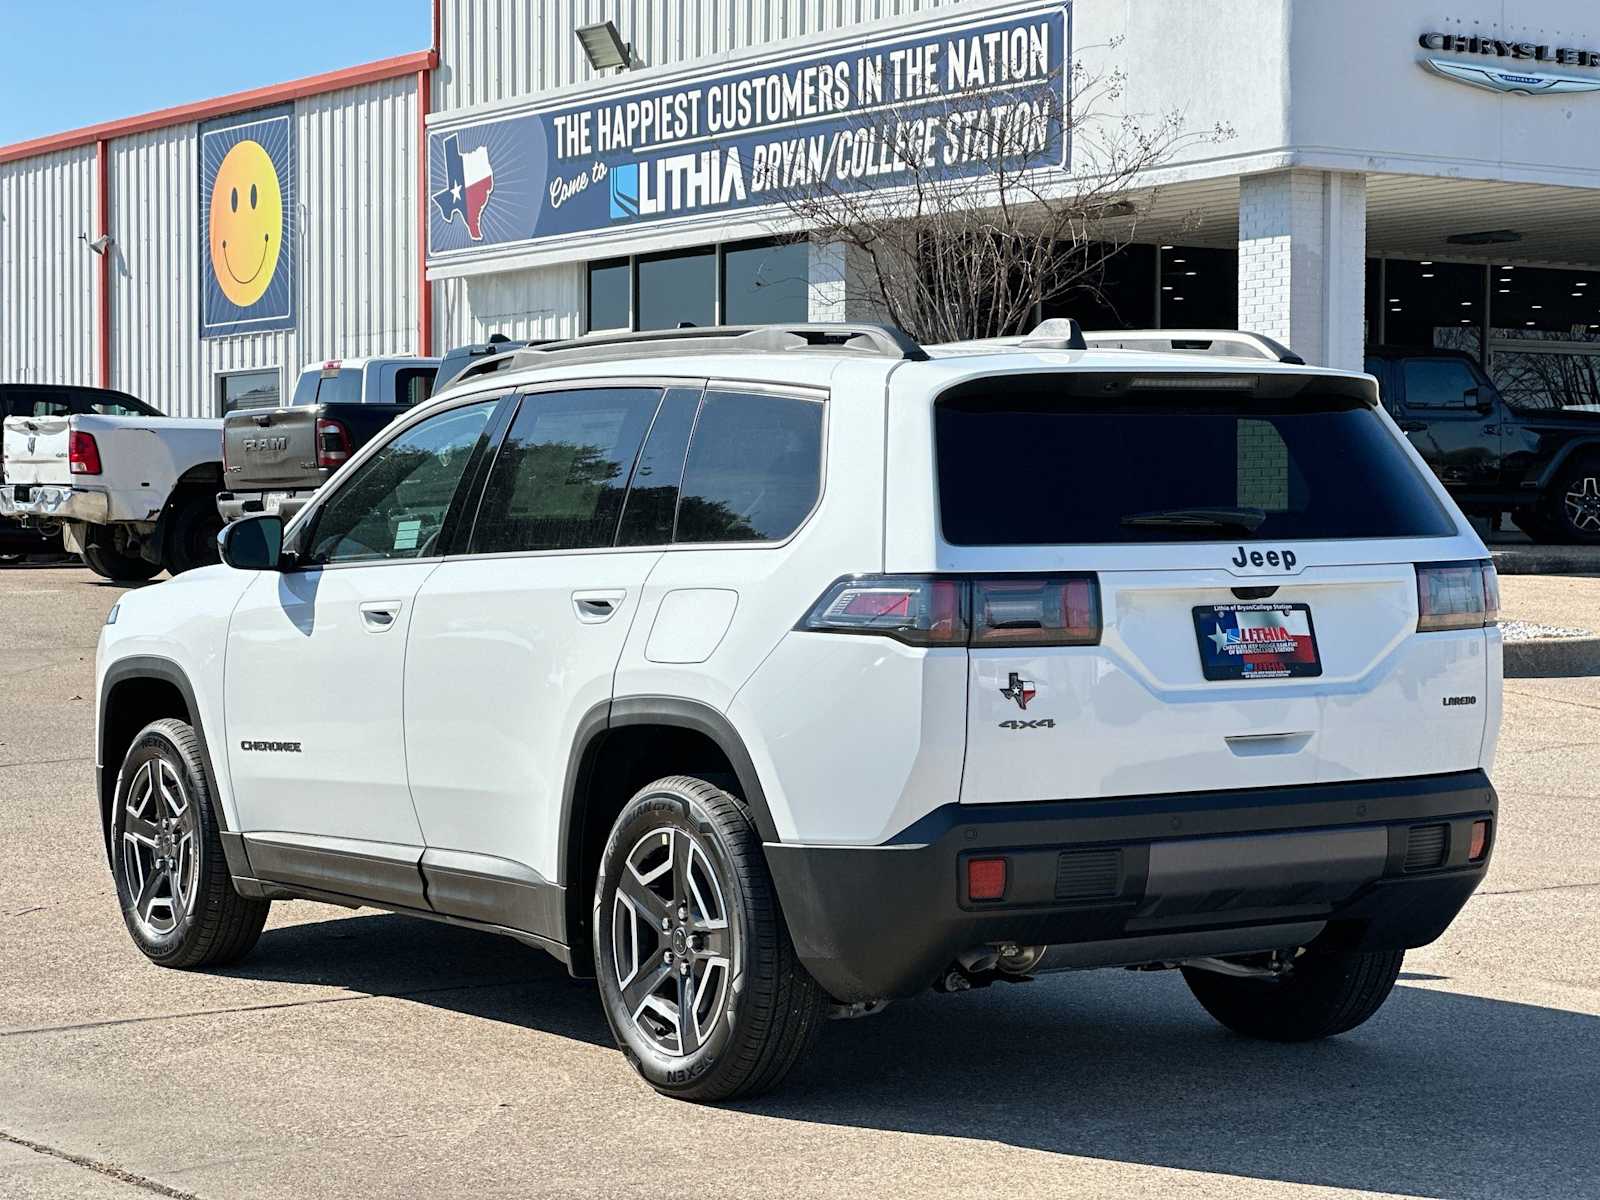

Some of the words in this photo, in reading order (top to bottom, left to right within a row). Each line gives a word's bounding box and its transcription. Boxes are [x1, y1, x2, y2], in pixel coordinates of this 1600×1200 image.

[1418, 31, 1600, 67] CHRYSLER
[554, 111, 592, 159] THE
[598, 89, 702, 152] HAPPIEST
[707, 61, 850, 132] CUSTOMERS
[857, 54, 882, 106] IN
[890, 44, 940, 100] THE
[948, 23, 1049, 91] NATION
[639, 146, 747, 215] LITHIA
[751, 116, 941, 193] BRYAN/COLLEGE
[943, 98, 1051, 166] STATION
[550, 169, 589, 208] Come
[592, 161, 608, 184] to
[243, 437, 287, 452] RAM
[1232, 546, 1296, 570] Jeep
[1241, 626, 1290, 643] LITHIA
[1442, 696, 1477, 706] LAREDO
[241, 740, 302, 752] CHEROKEE
